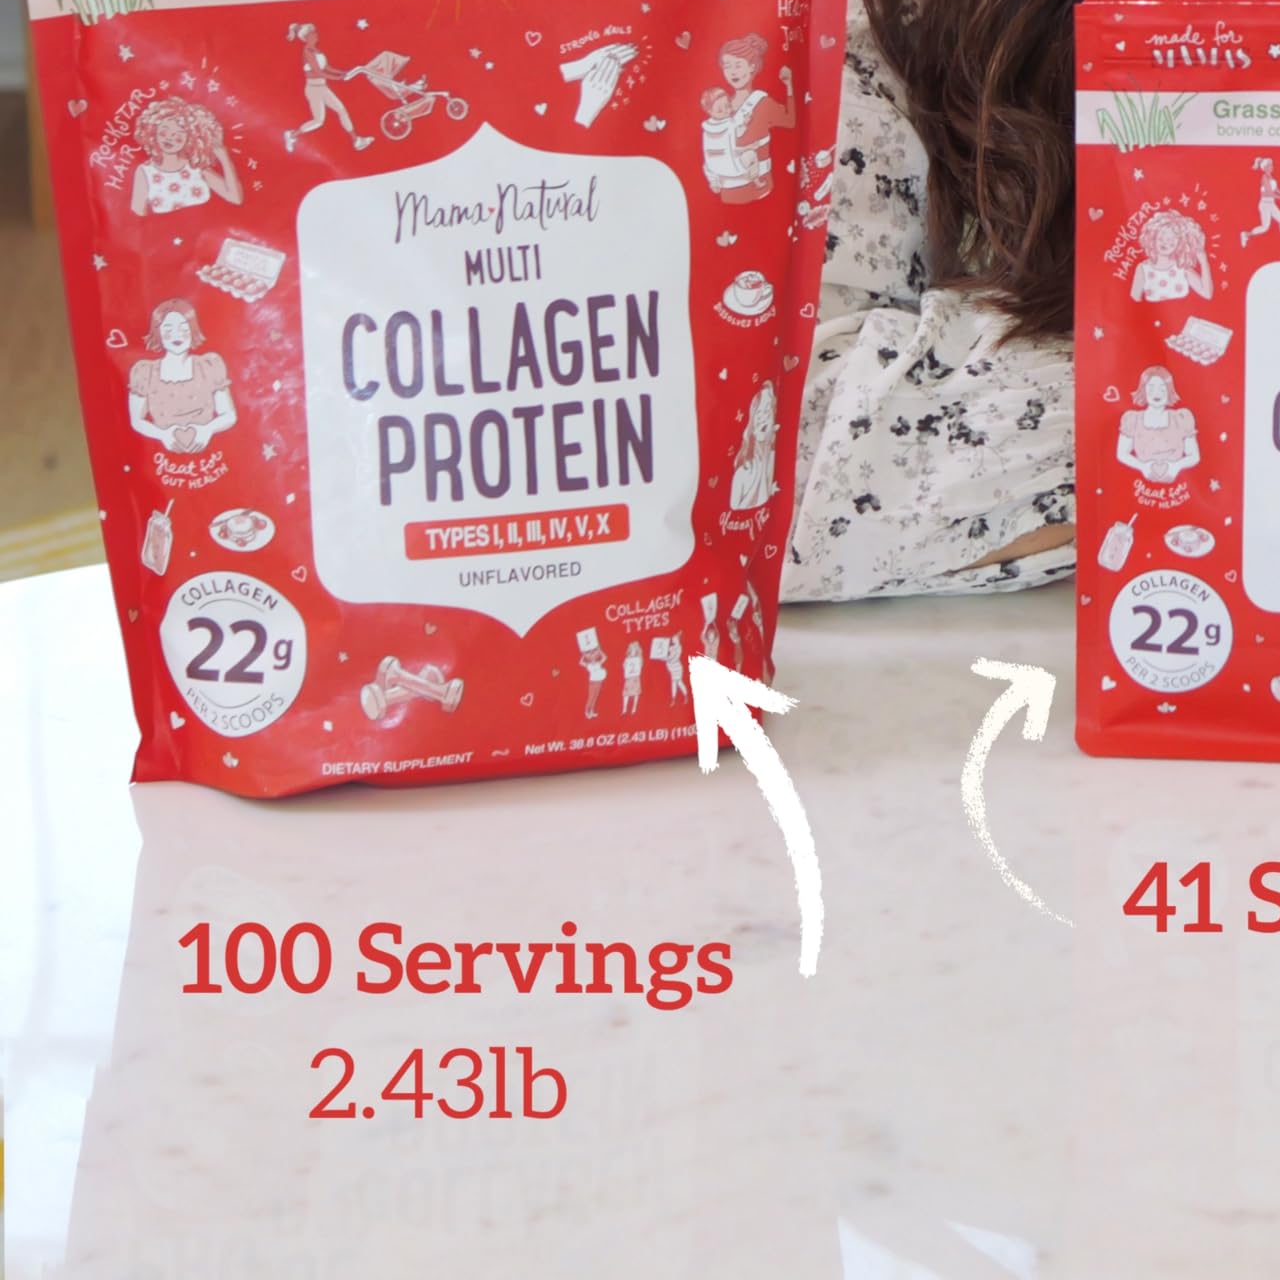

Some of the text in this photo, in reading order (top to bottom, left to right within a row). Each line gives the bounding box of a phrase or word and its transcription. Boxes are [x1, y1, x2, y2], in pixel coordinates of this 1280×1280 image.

[559, 25, 633, 54] STRONG NAILS
[1145, 20, 1243, 46] made for
[89, 88, 157, 169] ROCKSTAR
[1217, 123, 1264, 137] bovine
[104, 144, 142, 190] HAIR
[495, 175, 600, 234] Natural
[1103, 201, 1161, 263] ROCKSTAR
[465, 244, 542, 286] MULTI
[1112, 246, 1144, 280] HAIR
[342, 290, 659, 401] COLLAGEN
[378, 394, 654, 506] PROTEIN
[161, 463, 229, 489] GUT HEALTH
[1137, 492, 1191, 509] GUT HEALTH
[425, 524, 490, 550] TYPES
[596, 513, 611, 535] X
[459, 561, 582, 587] UNFLAVORED
[1131, 575, 1210, 602] COLLAGEN
[181, 578, 279, 611] COLLAGEN
[605, 588, 684, 622] COLLAGEN
[623, 612, 670, 634] TYPES
[1130, 604, 1222, 656] 22g
[185, 616, 294, 684] 22g
[1126, 655, 1216, 688] PER 2 SCOOPS
[185, 686, 286, 731] PER 2 SCOOPS
[525, 744, 546, 755] Net
[596, 734, 615, 746] OZ
[617, 731, 646, 745] (2.43
[648, 728, 668, 741] LB)
[322, 752, 474, 776] DIETARY SUPPLEMENT
